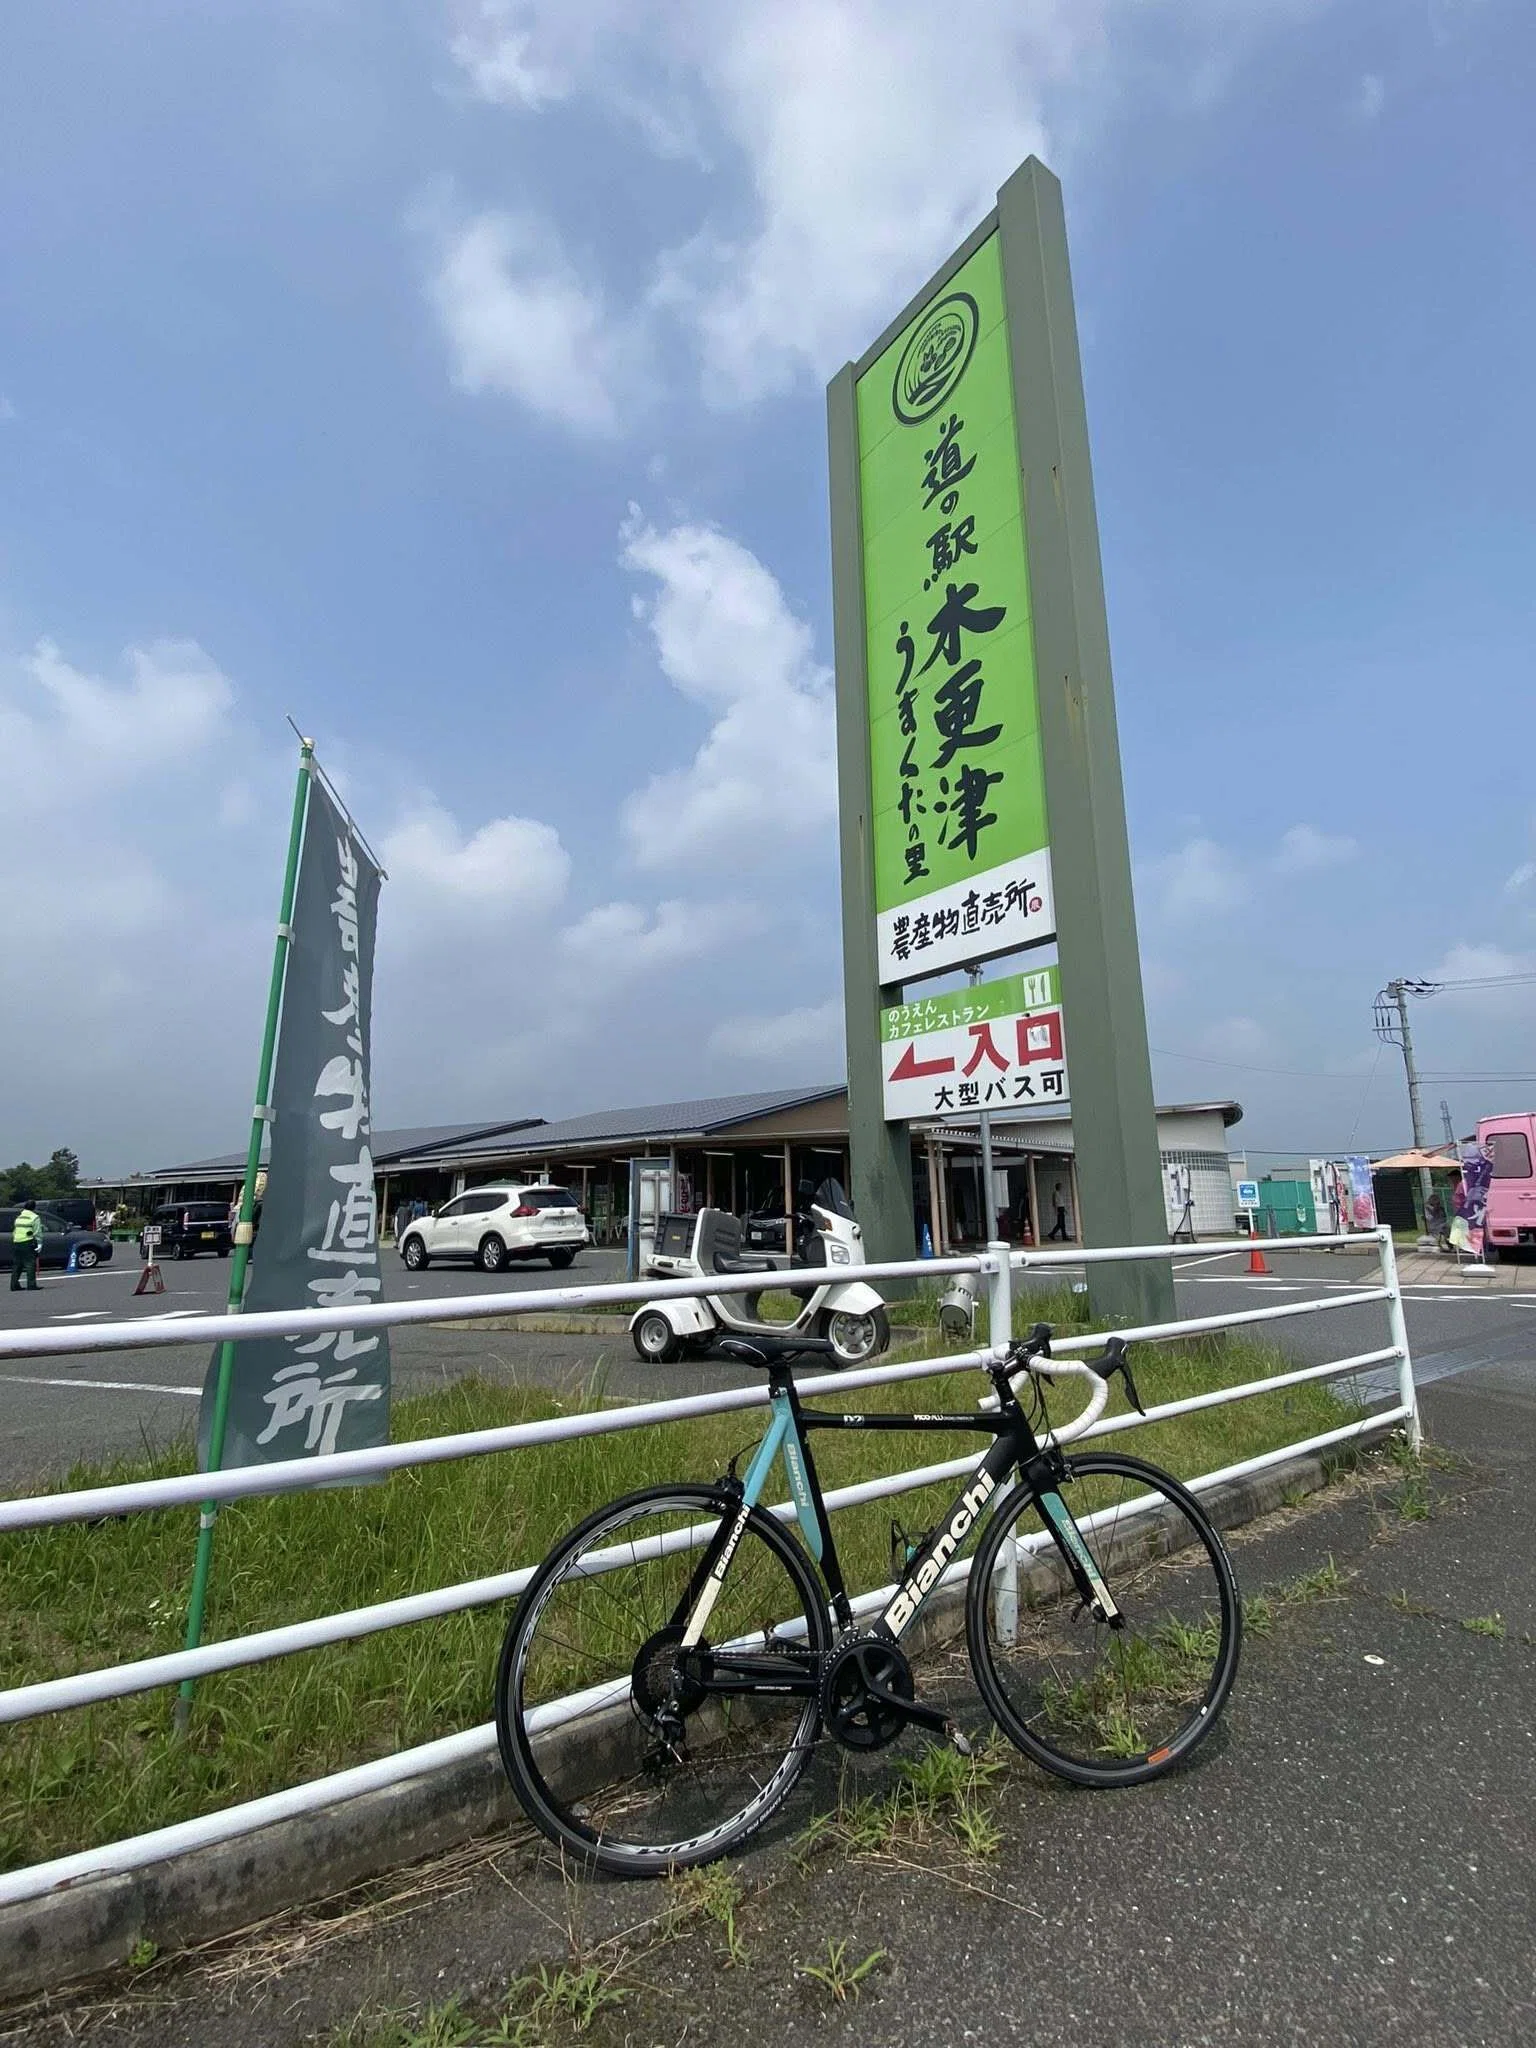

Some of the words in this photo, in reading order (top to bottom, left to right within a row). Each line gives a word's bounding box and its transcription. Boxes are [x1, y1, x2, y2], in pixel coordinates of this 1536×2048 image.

[896, 620, 930, 886] うまくたの里
[890, 878, 1037, 961] 農産物直売所
[888, 1000, 937, 1022] のうえん
[889, 1005, 989, 1039] カフェレストラン
[962, 1011, 1063, 1078] 入口
[934, 1069, 1065, 1111] 大型バス可
[786, 1443, 809, 1508] Bianchi
[714, 1504, 752, 1581] Bianchi
[885, 1470, 997, 1638] Bianchi
